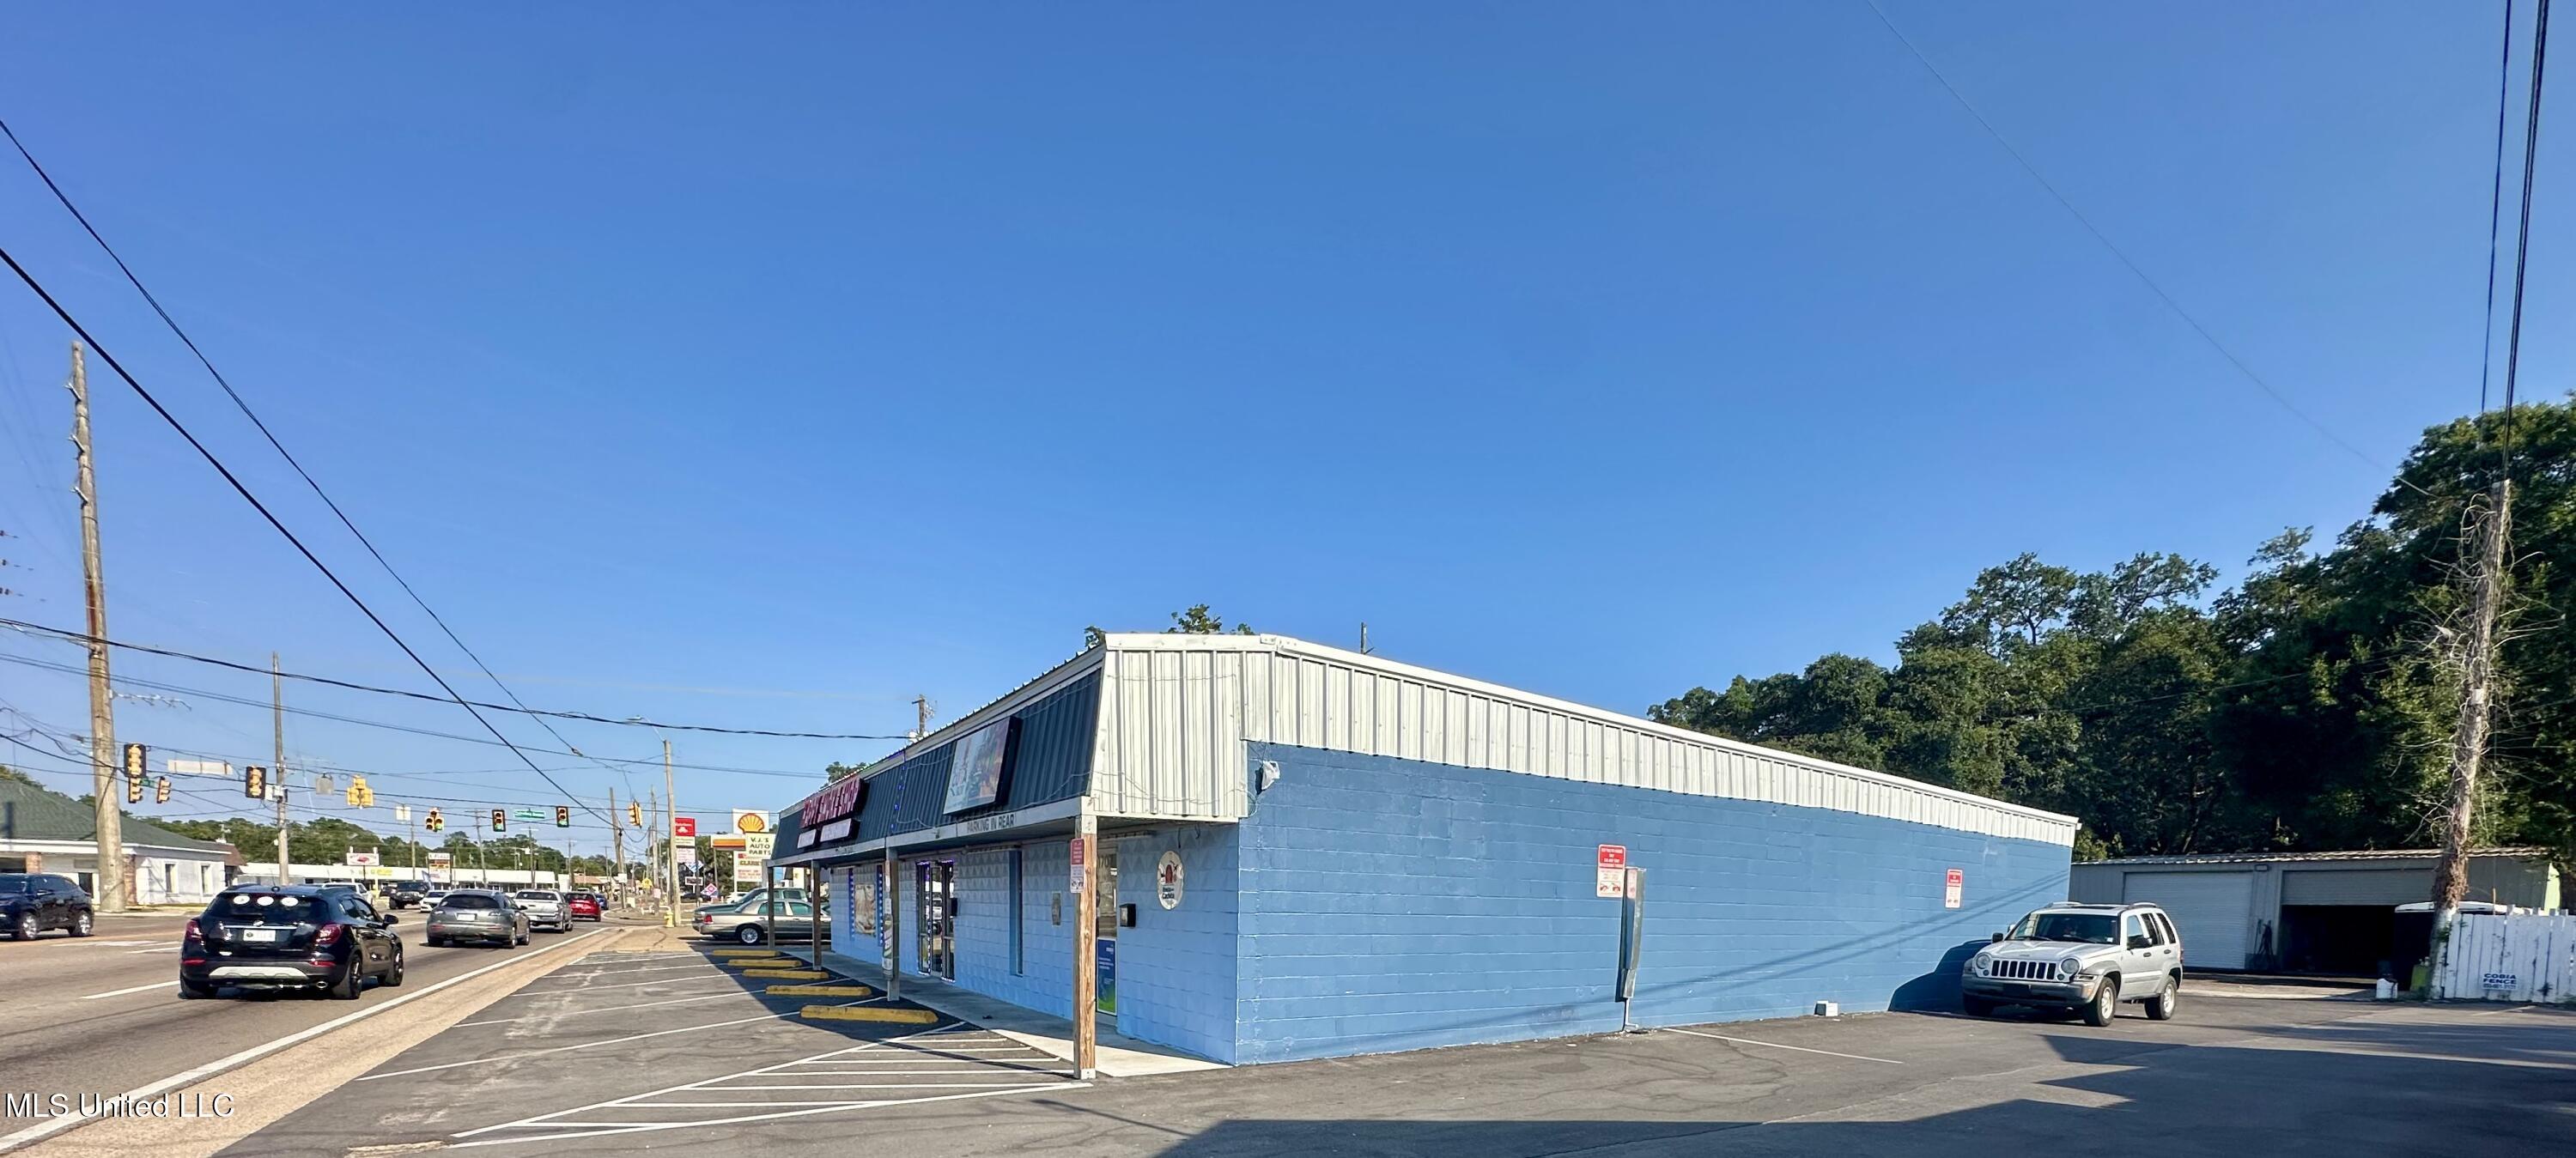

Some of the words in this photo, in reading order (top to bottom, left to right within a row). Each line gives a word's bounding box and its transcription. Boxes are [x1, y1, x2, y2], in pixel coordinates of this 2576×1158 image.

[967, 818, 989, 834] PARKING
[990, 817, 996, 830] IN
[998, 813, 1015, 828] REAR
